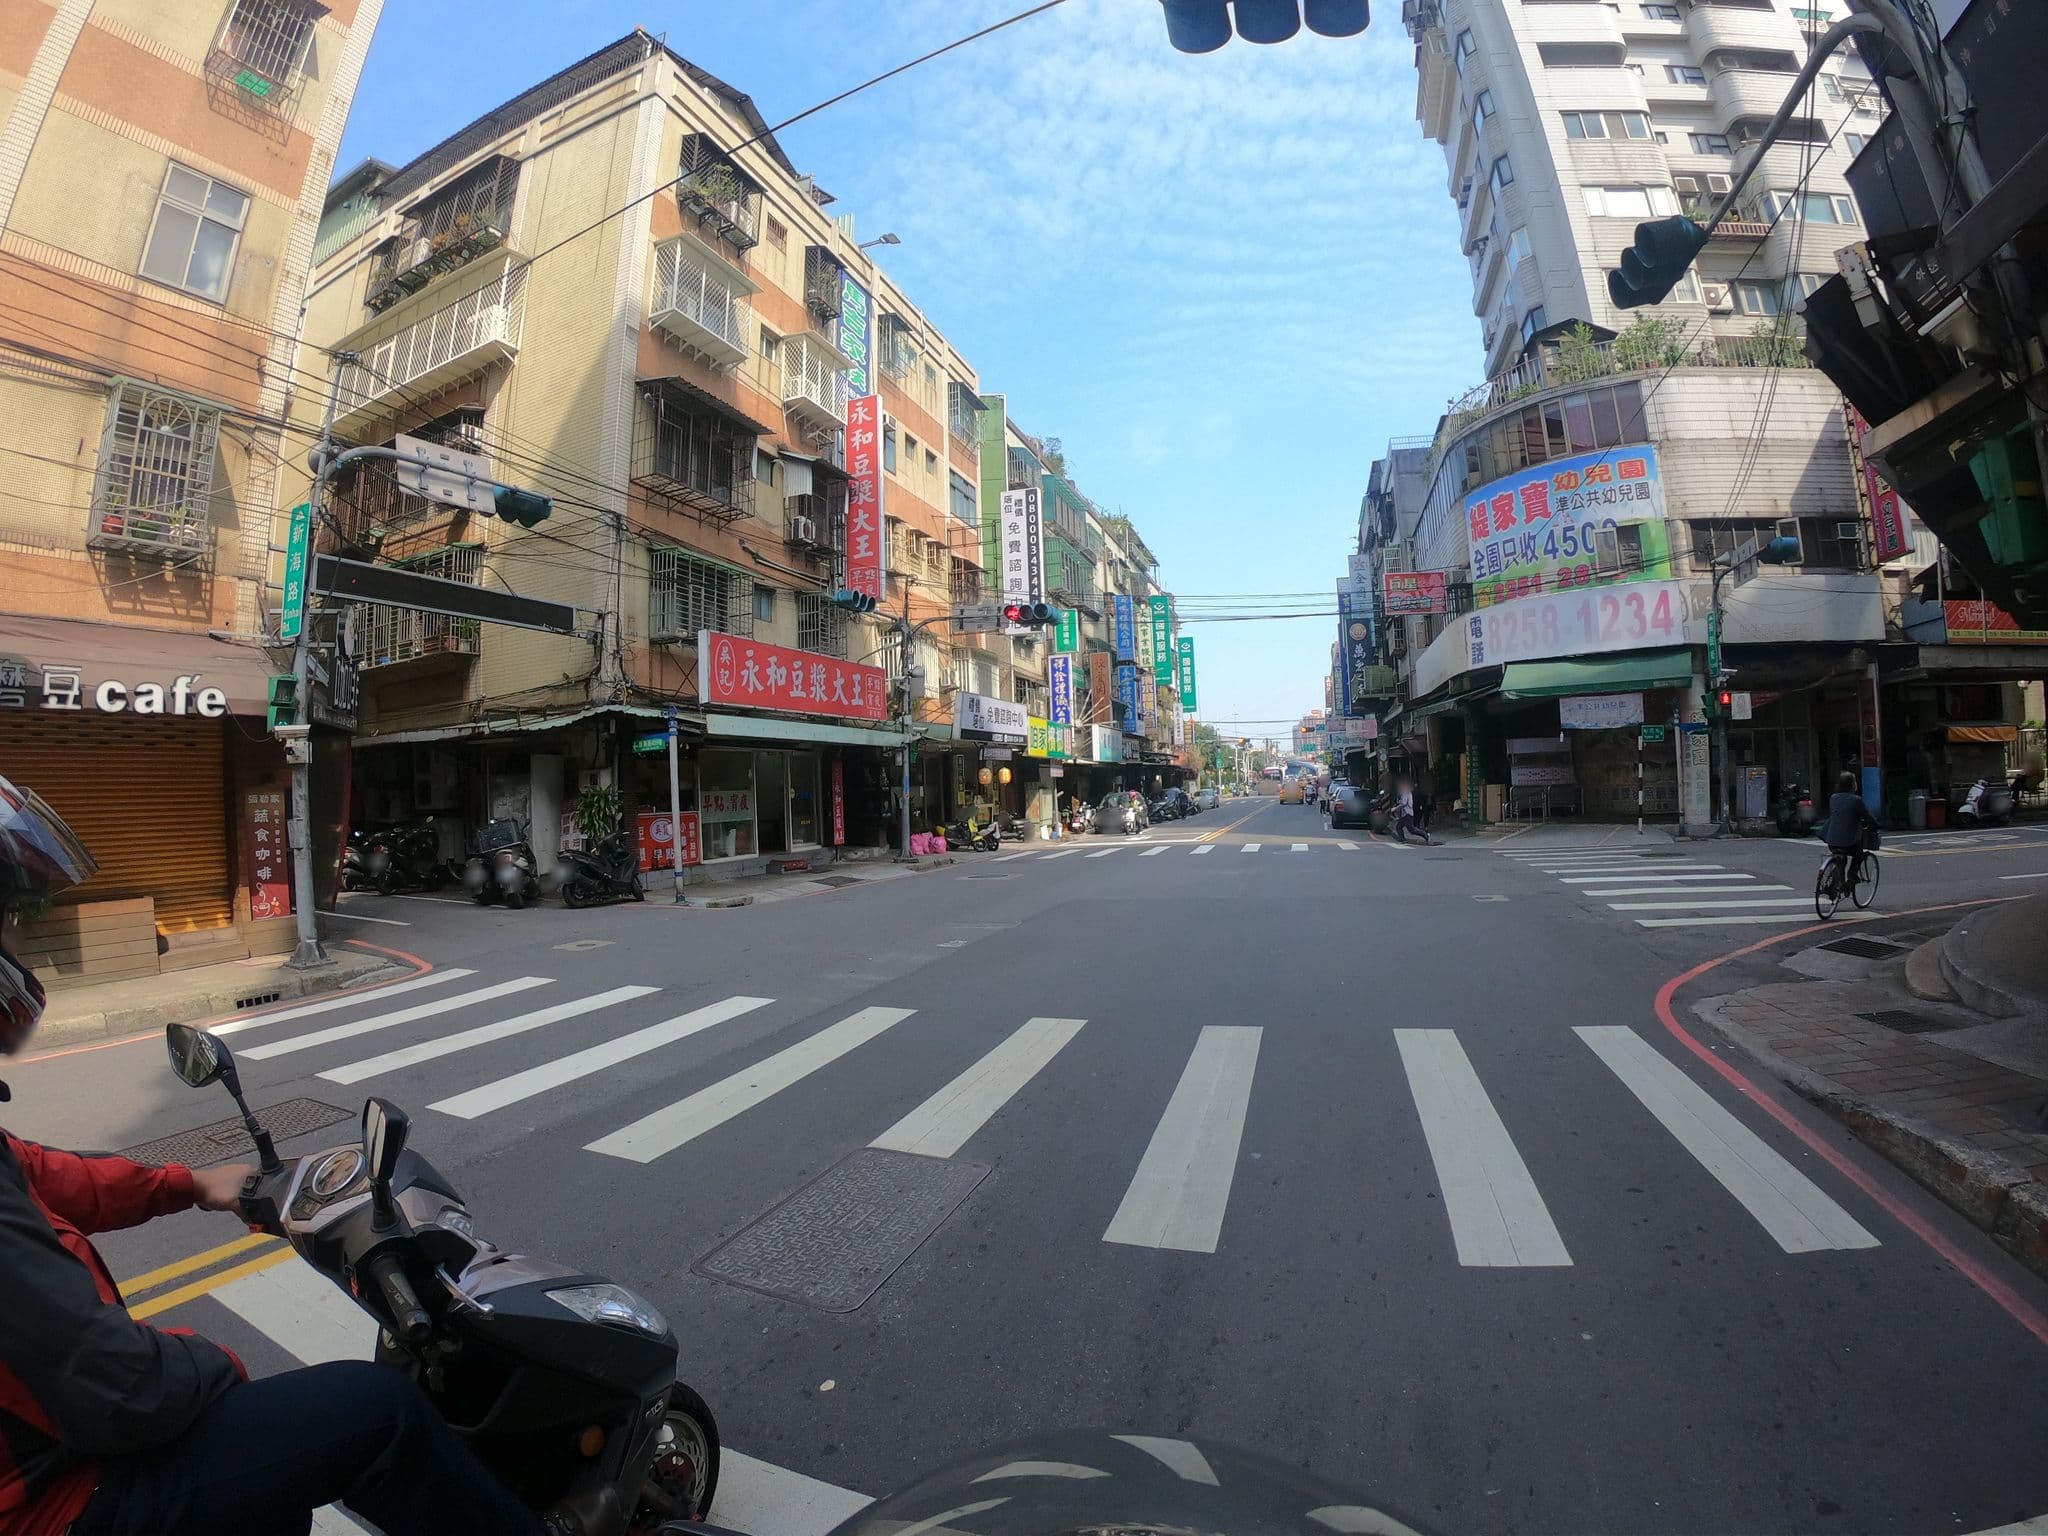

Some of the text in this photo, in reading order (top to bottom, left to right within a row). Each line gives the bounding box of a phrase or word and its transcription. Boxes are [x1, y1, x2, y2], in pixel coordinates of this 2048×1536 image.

[850, 402, 875, 559] 永和豆漿大王
[1552, 458, 1647, 492] 幼兒園
[1555, 482, 1650, 512] 準公共幼兒園
[287, 526, 304, 601] 新海路
[1470, 617, 1484, 664] 電話
[1576, 589, 1675, 645] 1234
[740, 650, 864, 706] 永和豆漿大王
[254, 808, 273, 881] 蔬食咖啡
